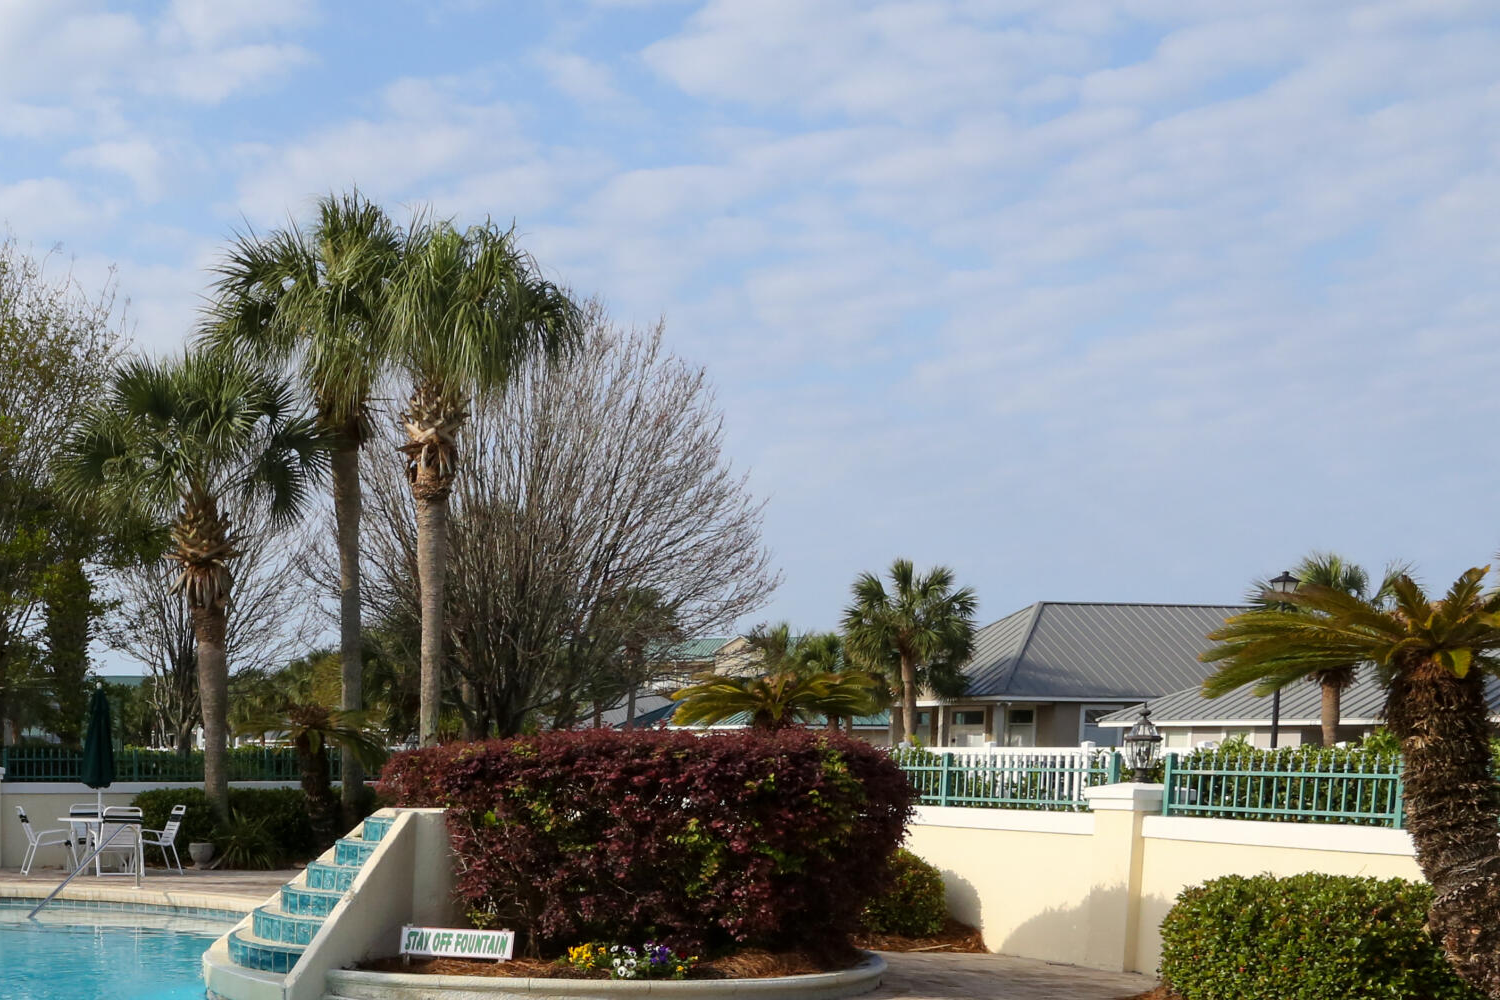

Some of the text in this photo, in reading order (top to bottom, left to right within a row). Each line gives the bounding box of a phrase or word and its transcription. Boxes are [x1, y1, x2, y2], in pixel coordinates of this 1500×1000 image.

[404, 931, 508, 955] STAY OFF FOUNTAIN
